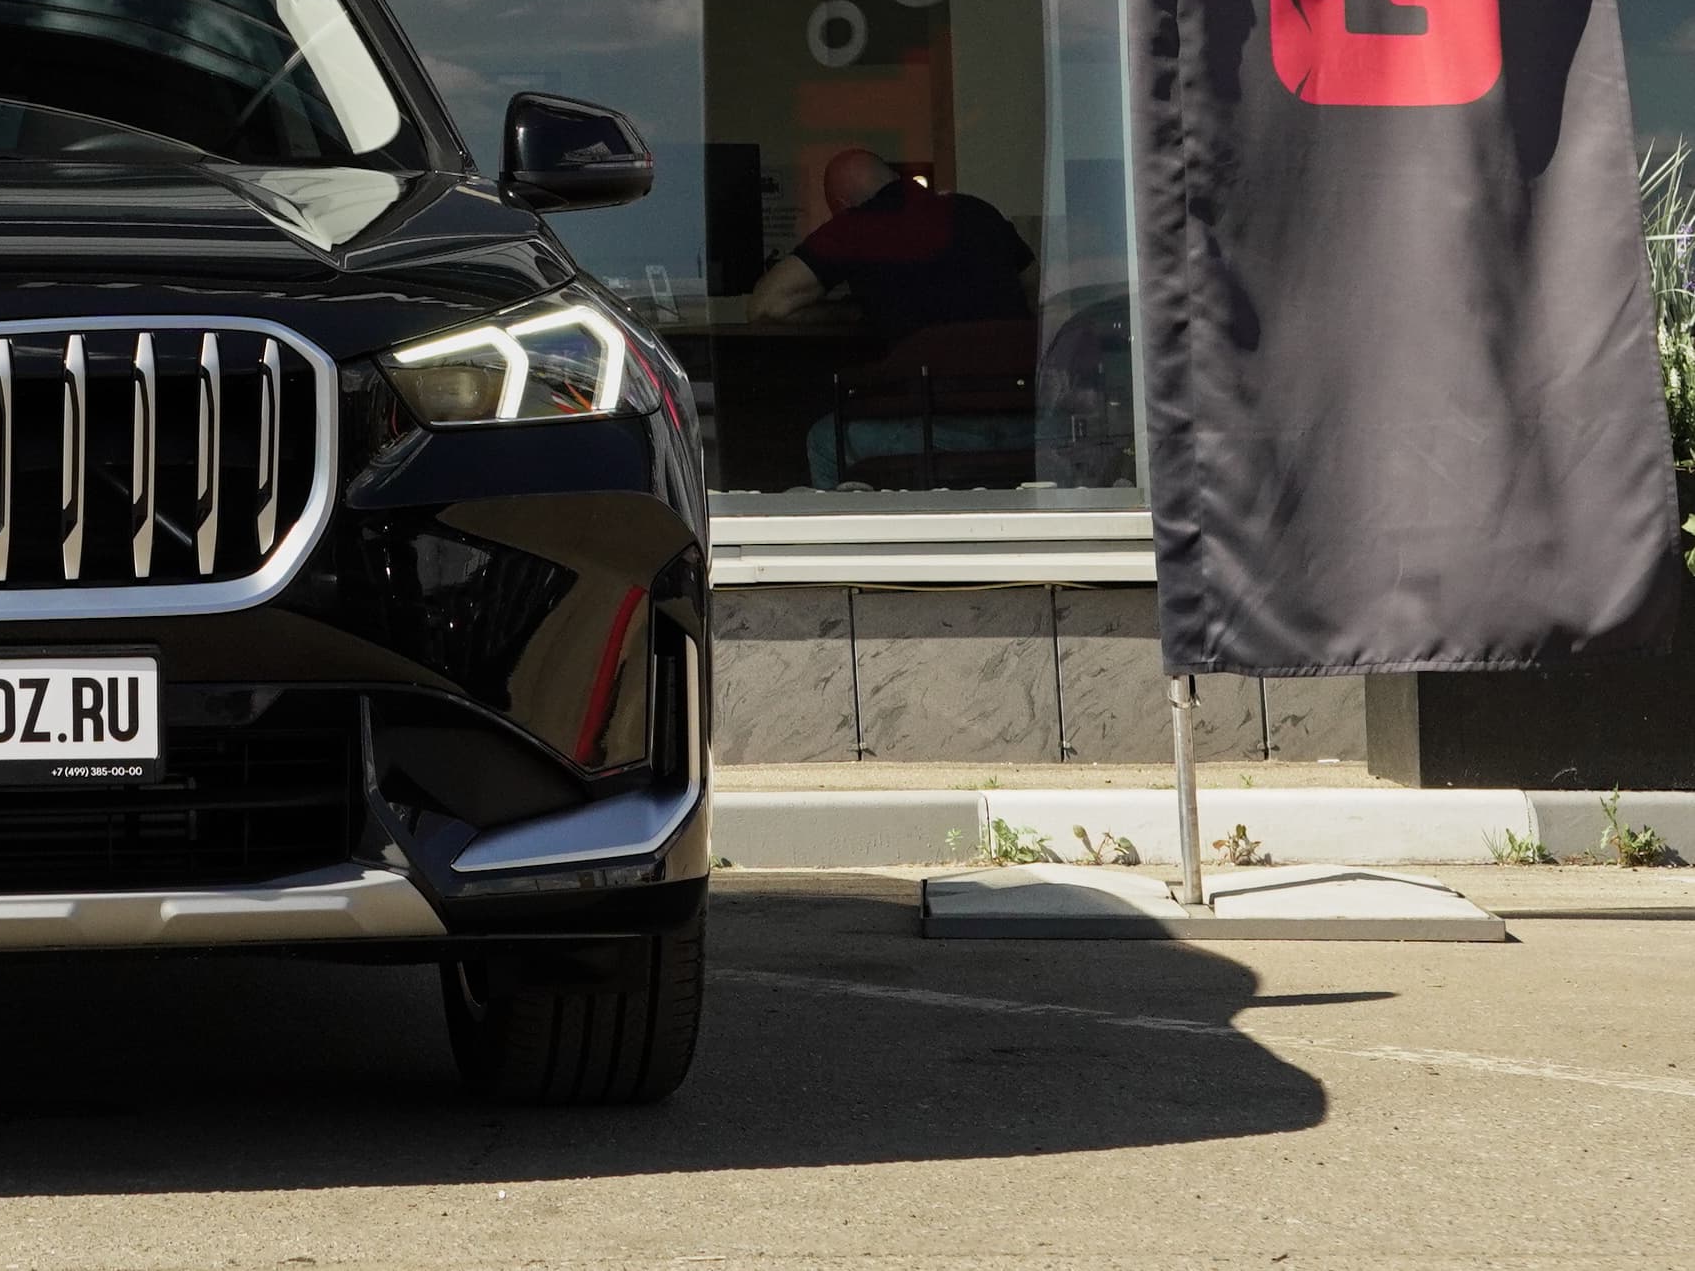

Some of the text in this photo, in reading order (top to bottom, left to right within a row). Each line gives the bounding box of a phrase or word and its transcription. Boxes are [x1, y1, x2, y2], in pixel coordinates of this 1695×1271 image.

[52, 766, 143, 777] +7 (499) 385-00-00
